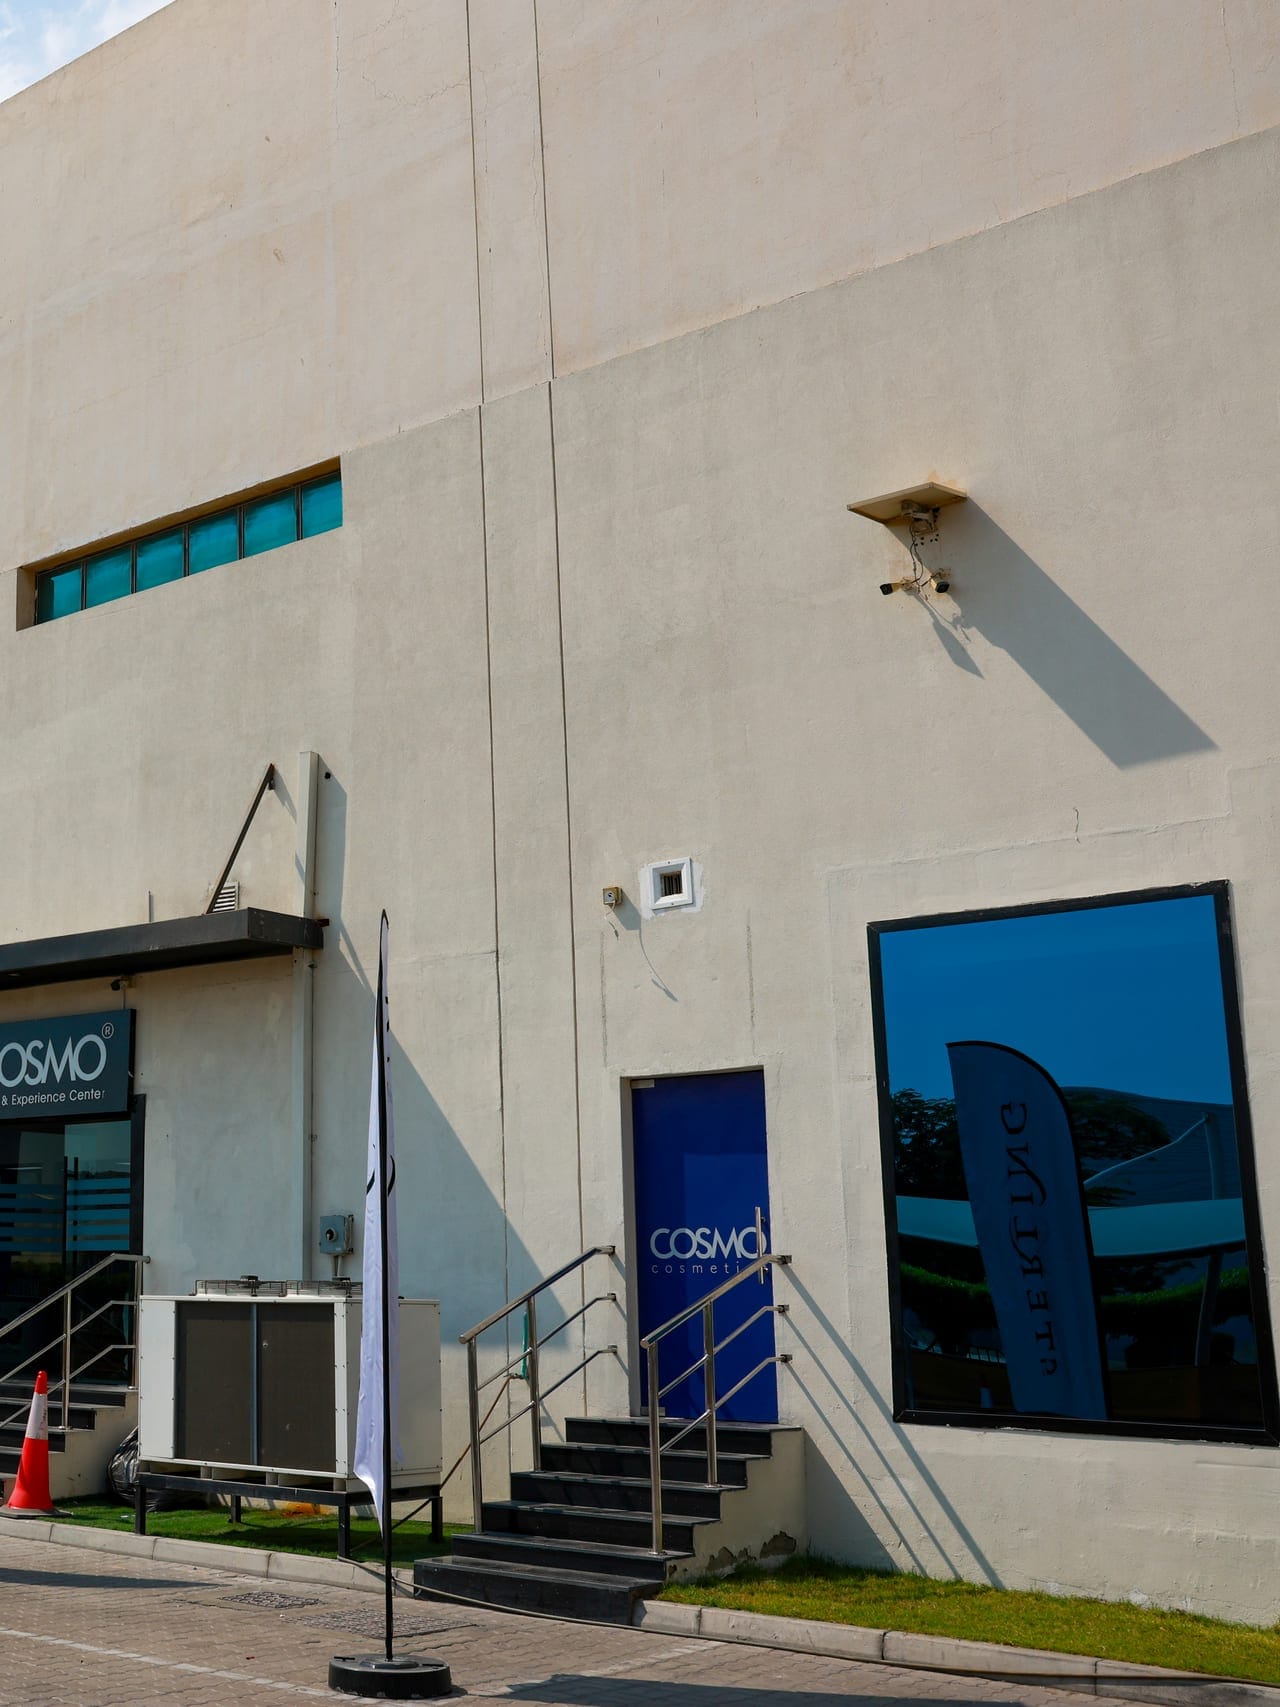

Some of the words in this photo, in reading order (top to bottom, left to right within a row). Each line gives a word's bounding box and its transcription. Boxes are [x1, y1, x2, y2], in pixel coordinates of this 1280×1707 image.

[1, 1095, 8, 1106] &
[11, 1091, 66, 1107] Experience
[650, 1227, 767, 1259] COSMO
[651, 1261, 740, 1274] cosmeti
